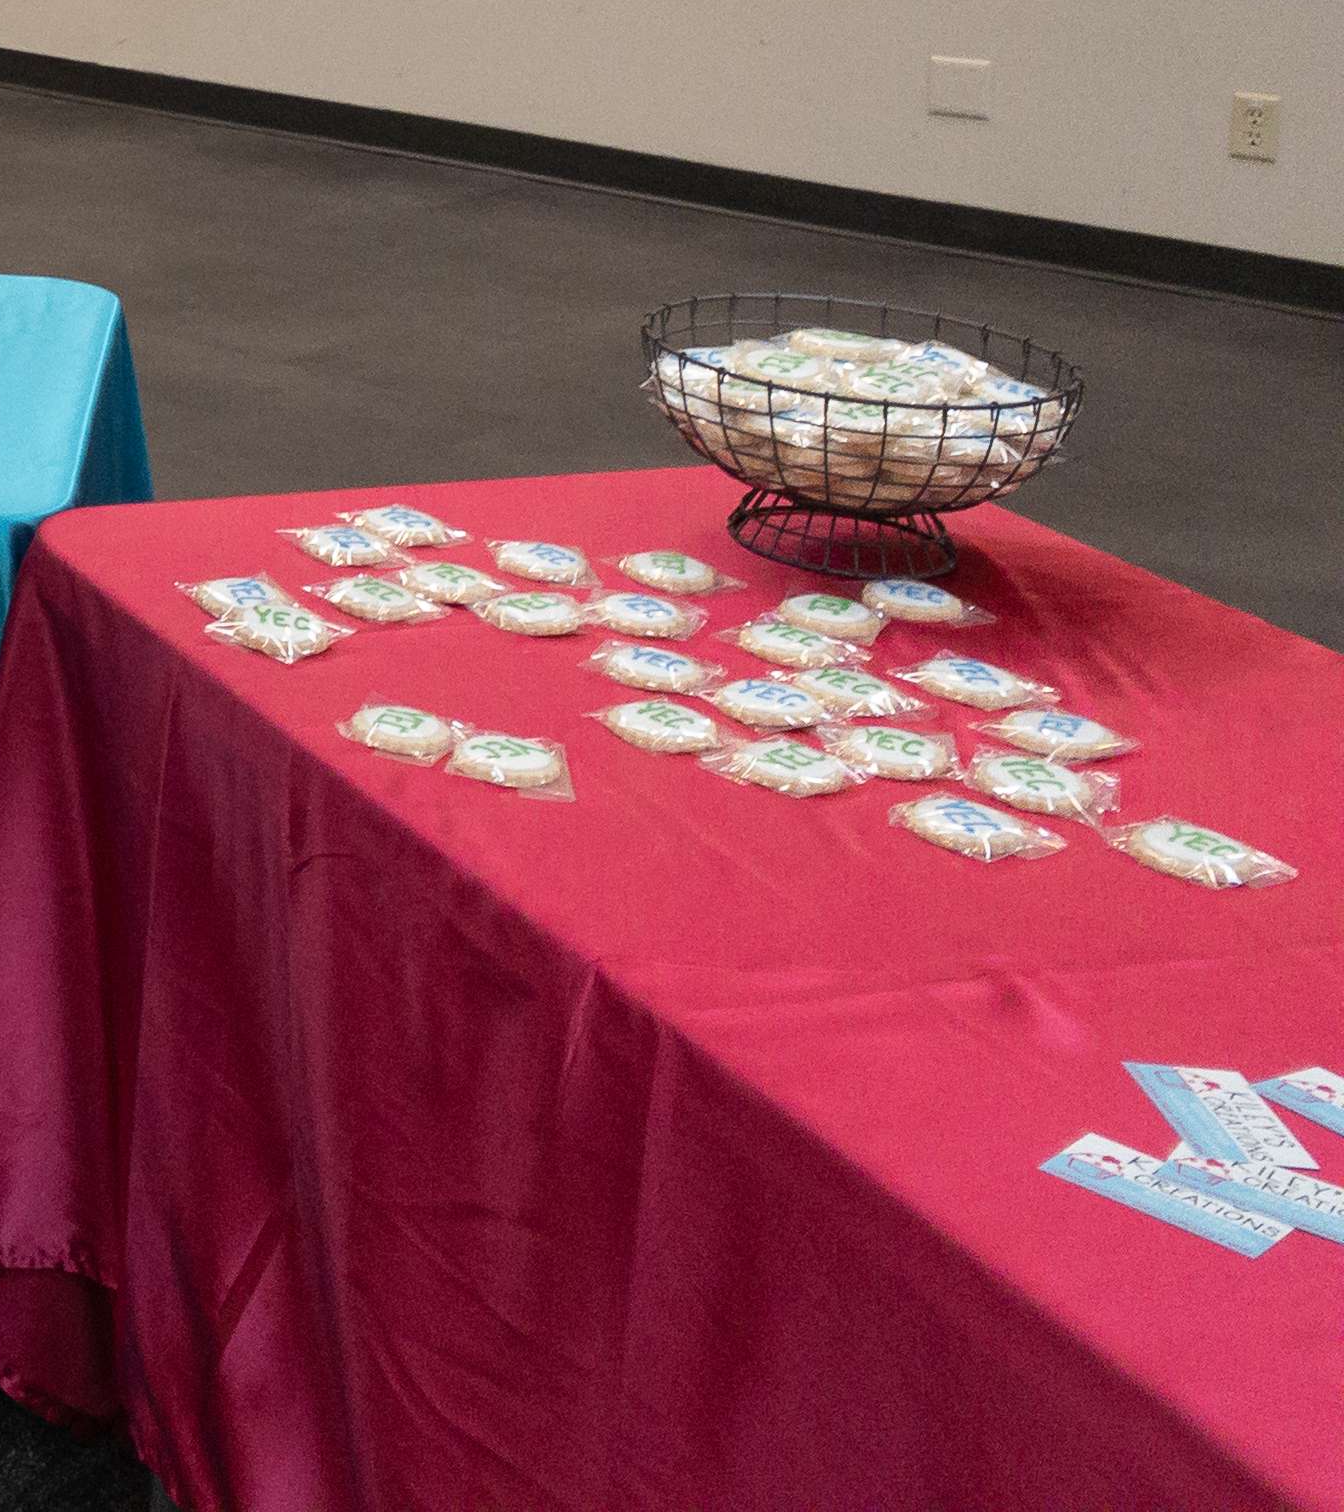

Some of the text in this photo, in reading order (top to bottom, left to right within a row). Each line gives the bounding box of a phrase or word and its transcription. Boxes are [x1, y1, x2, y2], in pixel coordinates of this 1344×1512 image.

[882, 577, 945, 604] YEC
[253, 605, 310, 631] YEC
[766, 623, 824, 647] YEC
[632, 647, 688, 672] YEC
[738, 679, 808, 707] YEC
[815, 668, 883, 695] YEC
[637, 702, 695, 730] YEC
[865, 727, 926, 756] YEC
[1166, 823, 1240, 857] YEC
